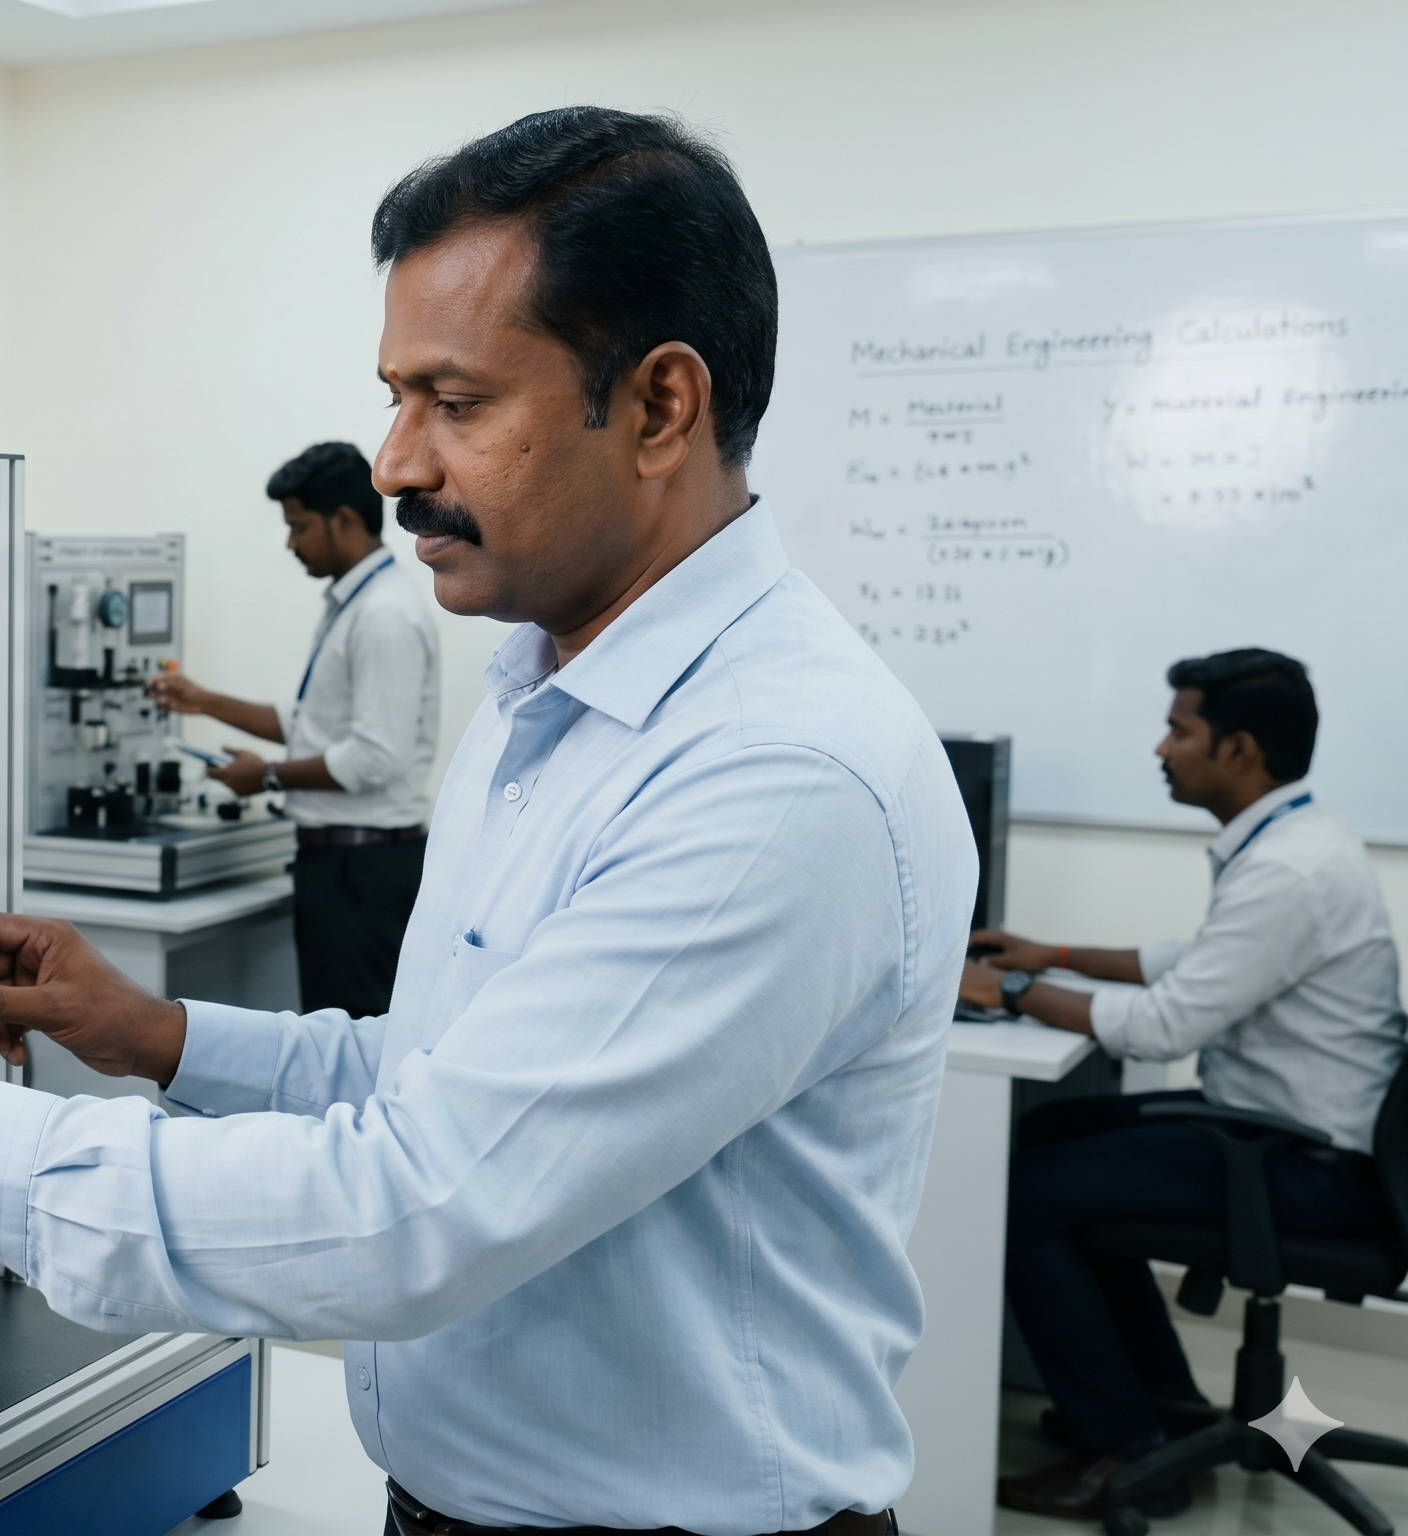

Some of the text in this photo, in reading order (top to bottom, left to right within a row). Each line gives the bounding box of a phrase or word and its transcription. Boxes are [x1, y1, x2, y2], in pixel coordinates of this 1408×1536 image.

[849, 312, 1350, 370] Mechanical Engineering Calculations
